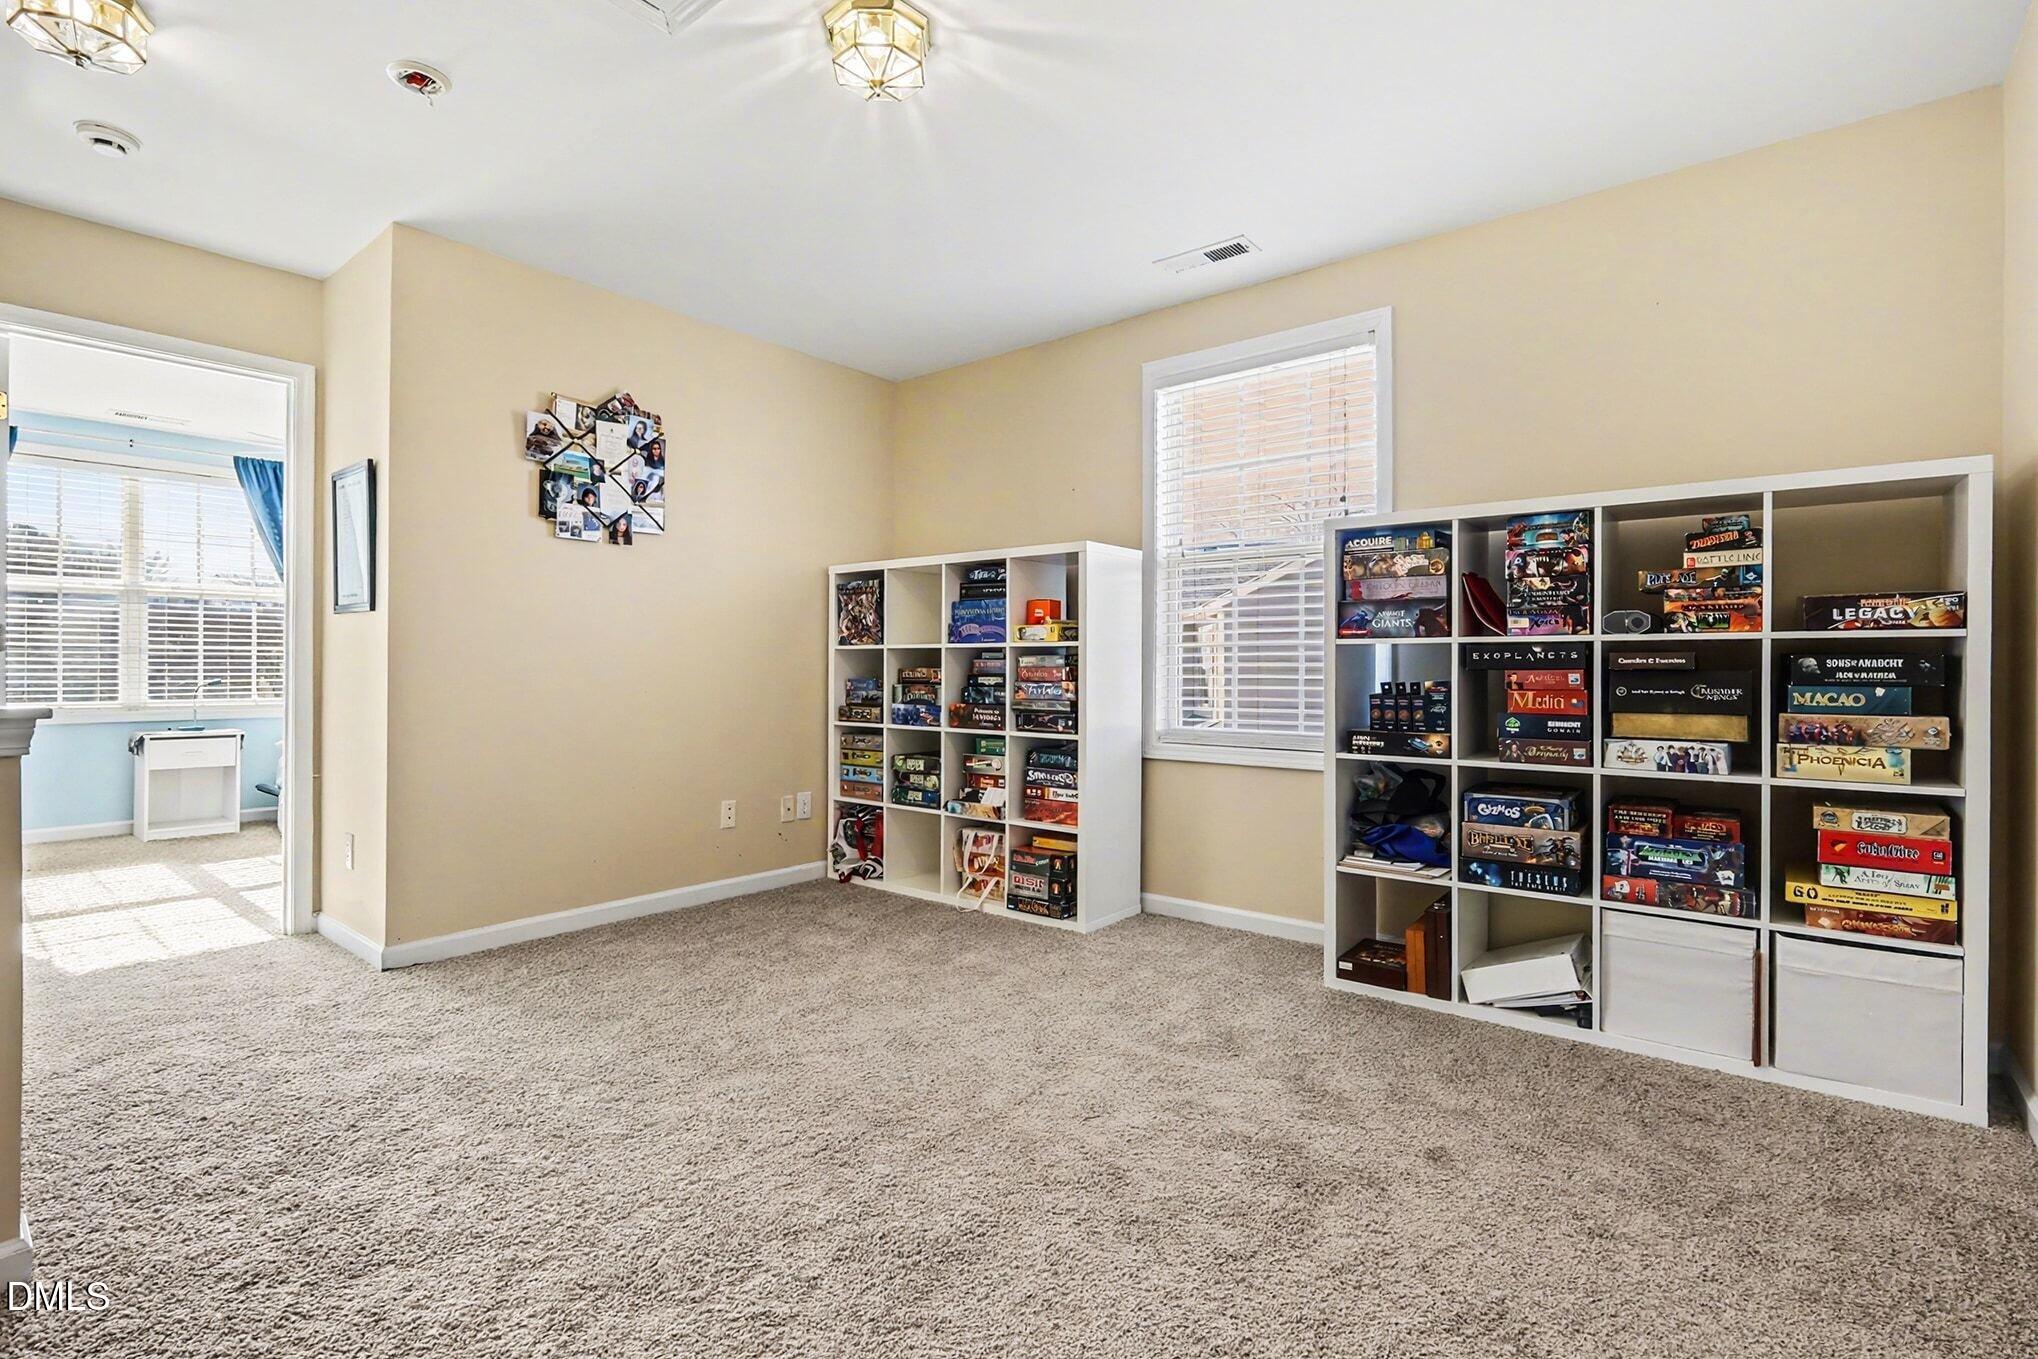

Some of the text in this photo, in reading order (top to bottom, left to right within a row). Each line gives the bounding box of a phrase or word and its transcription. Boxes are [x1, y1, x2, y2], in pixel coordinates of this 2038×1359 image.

[1832, 607, 1919, 621] LEGACY
[1372, 618, 1413, 628] GIANTS
[1508, 691, 1565, 711] Medici
[1792, 692, 1866, 707] MACAO
[1797, 753, 1887, 770] PHOENICIA
